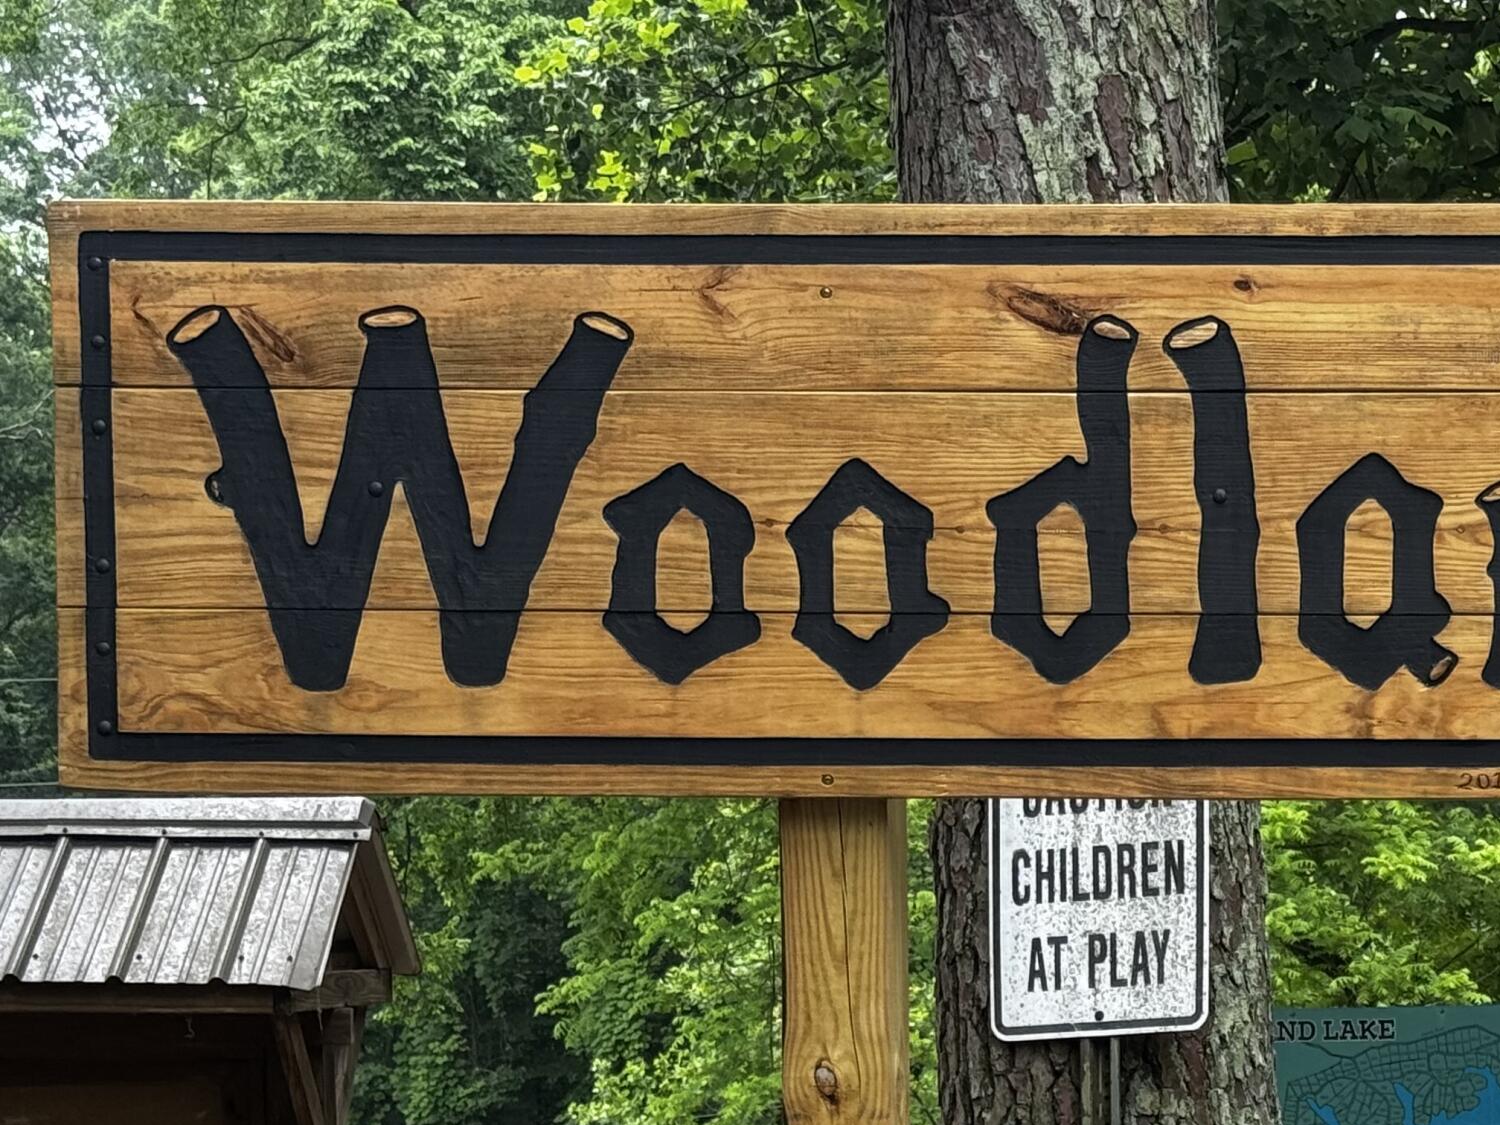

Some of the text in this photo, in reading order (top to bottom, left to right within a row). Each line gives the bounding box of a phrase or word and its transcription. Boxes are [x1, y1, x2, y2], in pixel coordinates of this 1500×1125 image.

[1011, 840, 1186, 906] CHILDREN
[1027, 929, 1171, 992] AT PLAY
[1323, 1019, 1395, 1041] LAKE
